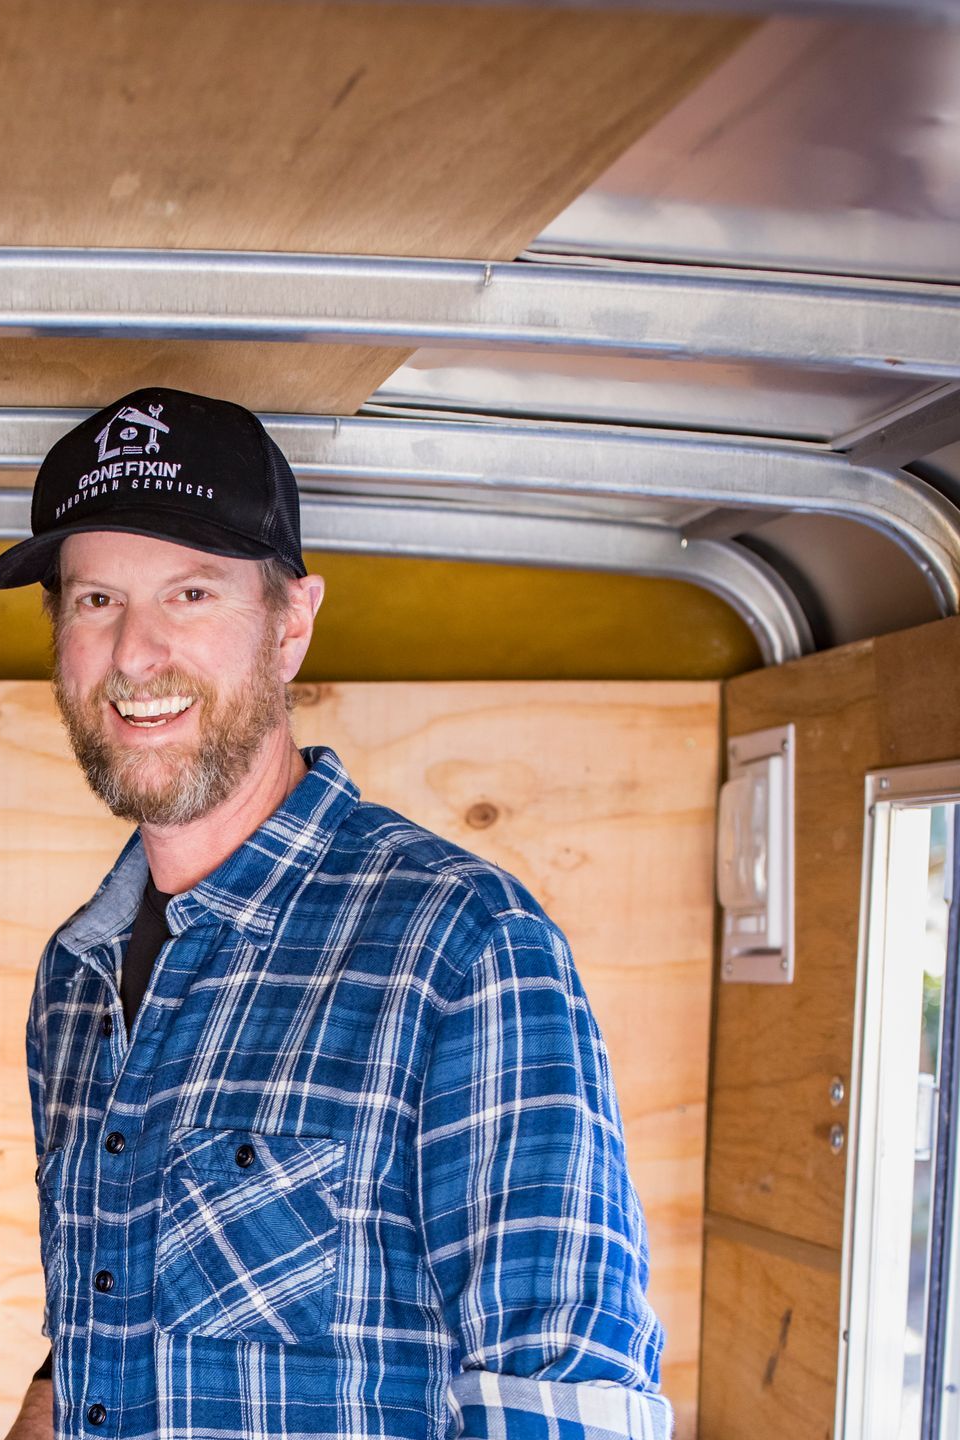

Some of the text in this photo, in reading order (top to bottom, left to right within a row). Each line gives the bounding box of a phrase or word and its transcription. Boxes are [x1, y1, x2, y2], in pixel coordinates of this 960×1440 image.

[78, 460, 182, 490] GONE FIXIN'
[55, 478, 214, 520] HANDYMAN SERVICES
